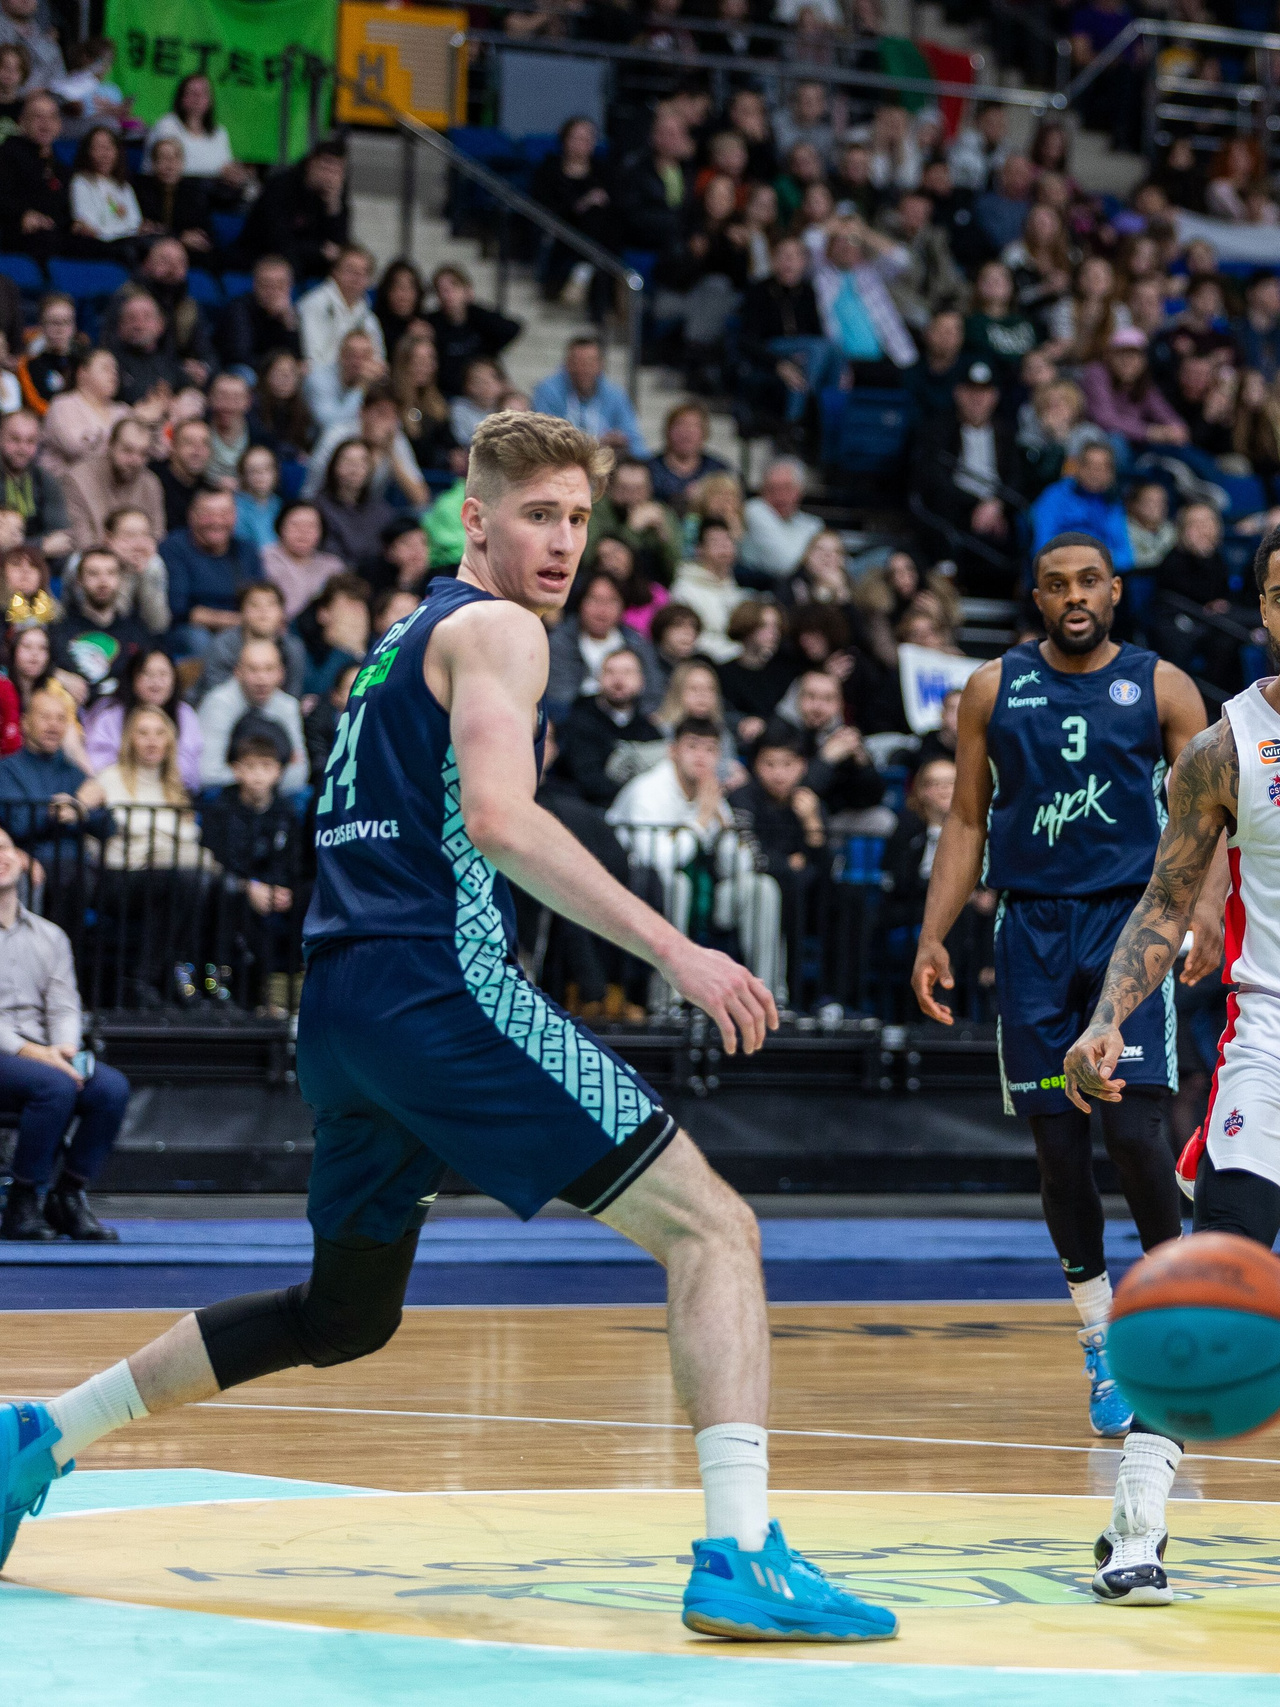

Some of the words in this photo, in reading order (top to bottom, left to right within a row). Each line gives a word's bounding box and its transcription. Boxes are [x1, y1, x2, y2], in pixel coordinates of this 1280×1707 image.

[1007, 696, 1048, 709] Kempa
[1060, 715, 1088, 763] 3
[317, 702, 367, 815] 24
[1225, 1116, 1243, 1128] CSKA
